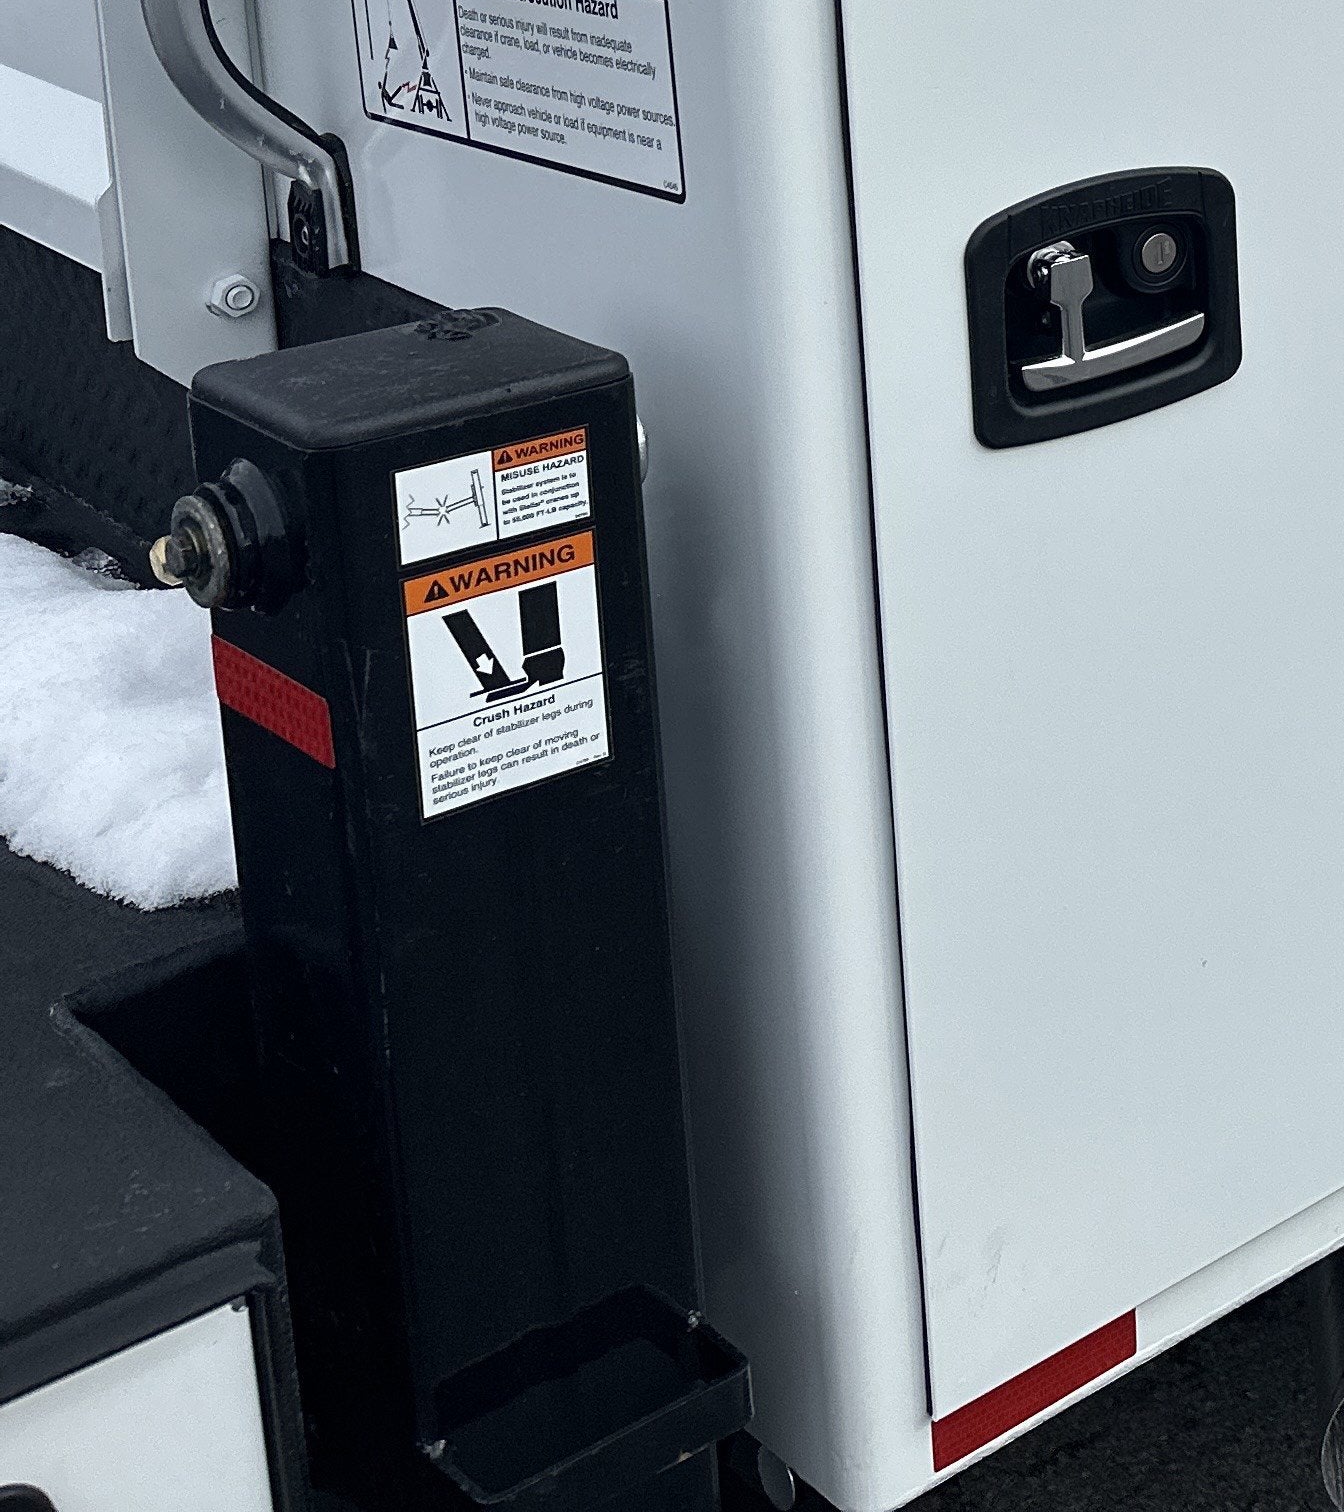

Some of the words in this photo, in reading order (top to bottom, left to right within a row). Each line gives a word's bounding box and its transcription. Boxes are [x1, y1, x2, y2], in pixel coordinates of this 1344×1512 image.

[458, 5, 478, 21] Death
[480, 12, 487, 23] or
[489, 14, 514, 29] serious
[515, 20, 534, 36] injury
[536, 21, 548, 36] will
[549, 26, 569, 41] result
[571, 29, 588, 43] from
[589, 33, 633, 53] inadequate
[460, 24, 493, 42] clearance
[494, 30, 499, 43] if
[500, 33, 523, 49] crane,
[523, 37, 541, 55] load,
[542, 43, 551, 54] or
[551, 44, 578, 61] vehicle
[579, 48, 614, 68] becomes
[615, 58, 656, 80] electrically
[462, 43, 491, 60] charged.
[469, 67, 498, 85] Maintain
[499, 75, 514, 89] safe
[515, 78, 551, 98] clearance
[552, 85, 569, 102] from
[570, 90, 586, 108] high
[587, 96, 615, 115] voltage
[617, 103, 641, 118] power
[642, 109, 676, 127] sources.
[472, 91, 492, 108] Never
[493, 99, 526, 117] approach
[527, 107, 552, 124] vehicle
[554, 114, 562, 125] or
[563, 113, 579, 129] load
[580, 117, 585, 131] if
[587, 121, 627, 143] equipment
[628, 131, 635, 144] is
[637, 133, 654, 149] near
[656, 139, 662, 151] a
[475, 109, 490, 127] high
[491, 116, 516, 134] voltage
[517, 122, 539, 136] power
[540, 128, 567, 145] source.
[501, 465, 540, 482] MISUSE
[543, 455, 584, 472] HAZARD
[515, 434, 584, 459] WARNING
[450, 543, 575, 593] WARNING
[428, 743, 455, 757] Keep
[457, 734, 481, 747] clear
[484, 728, 494, 739] of
[496, 716, 539, 736] stabilizer
[542, 709, 561, 722] legs
[564, 698, 594, 715] during
[473, 710, 510, 727] Crush
[514, 694, 556, 716] Hazard
[429, 747, 478, 768] operation.
[431, 766, 466, 783] Failure
[468, 761, 477, 771] to
[479, 753, 504, 768] keep
[505, 744, 531, 758] clear
[533, 739, 543, 750] of
[545, 729, 579, 747] moving
[432, 774, 475, 794] stabilizer
[477, 766, 499, 781] legs
[500, 760, 519, 771] can
[522, 750, 548, 765] result
[551, 744, 559, 755] in
[562, 736, 588, 751] death
[590, 732, 600, 741] or
[432, 789, 469, 805] serious
